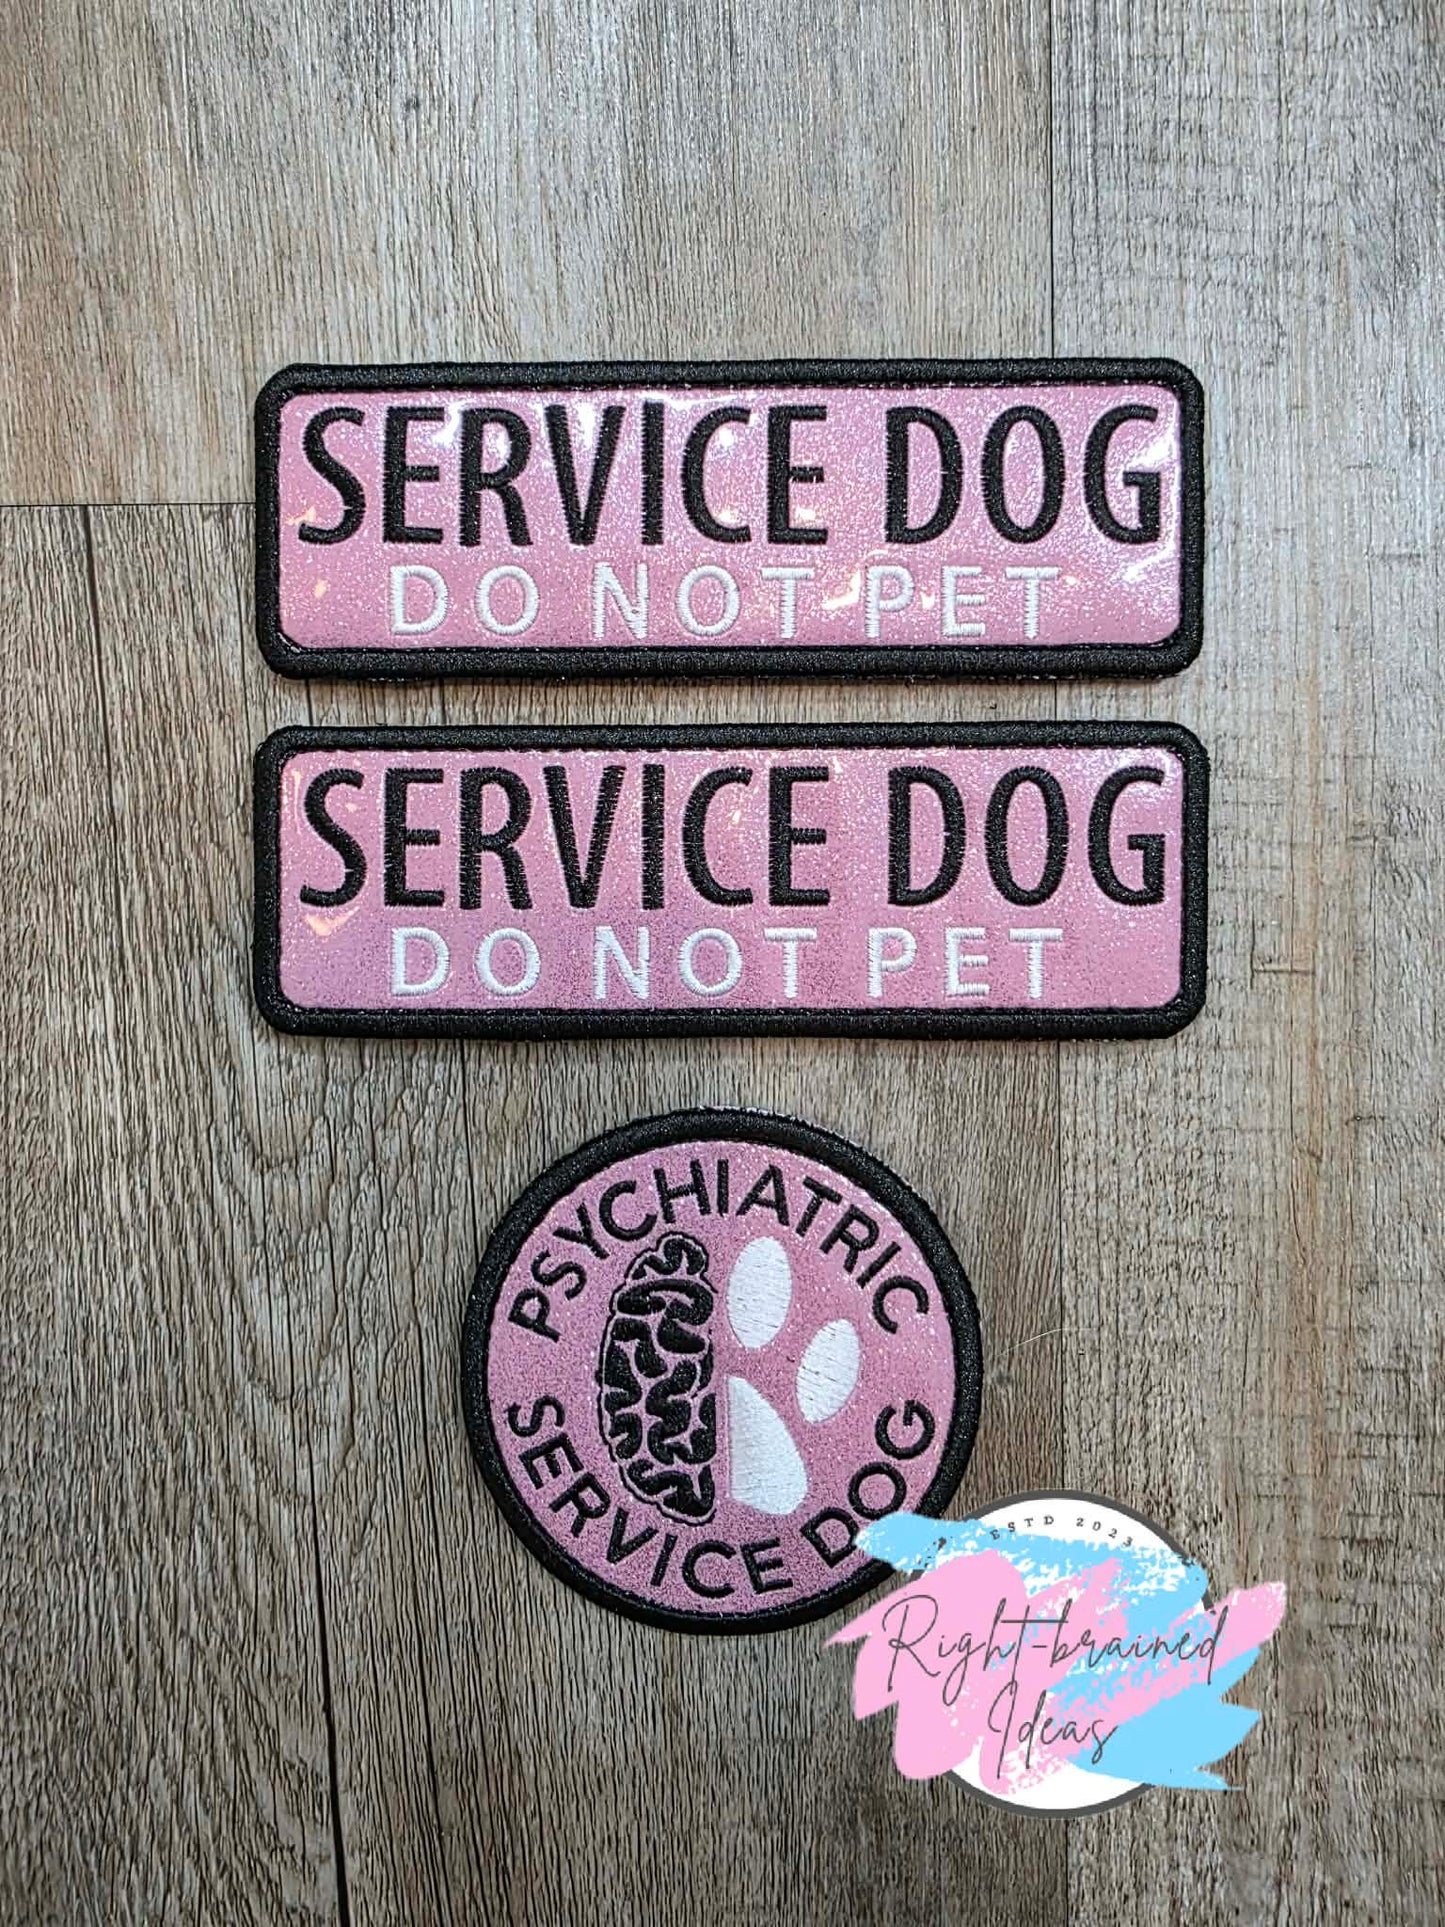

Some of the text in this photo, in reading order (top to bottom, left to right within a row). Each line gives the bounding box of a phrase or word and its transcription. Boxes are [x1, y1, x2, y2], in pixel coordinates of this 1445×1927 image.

[298, 400, 1161, 546] SERVICE DOG
[389, 563, 1059, 640] DO NOT PET
[300, 764, 1166, 911] SERVICE DOG
[391, 925, 1063, 1000] DO NOT PET
[508, 1158, 930, 1343] PSYCHIATRIC
[507, 1394, 936, 1598] SERVICE DOG
